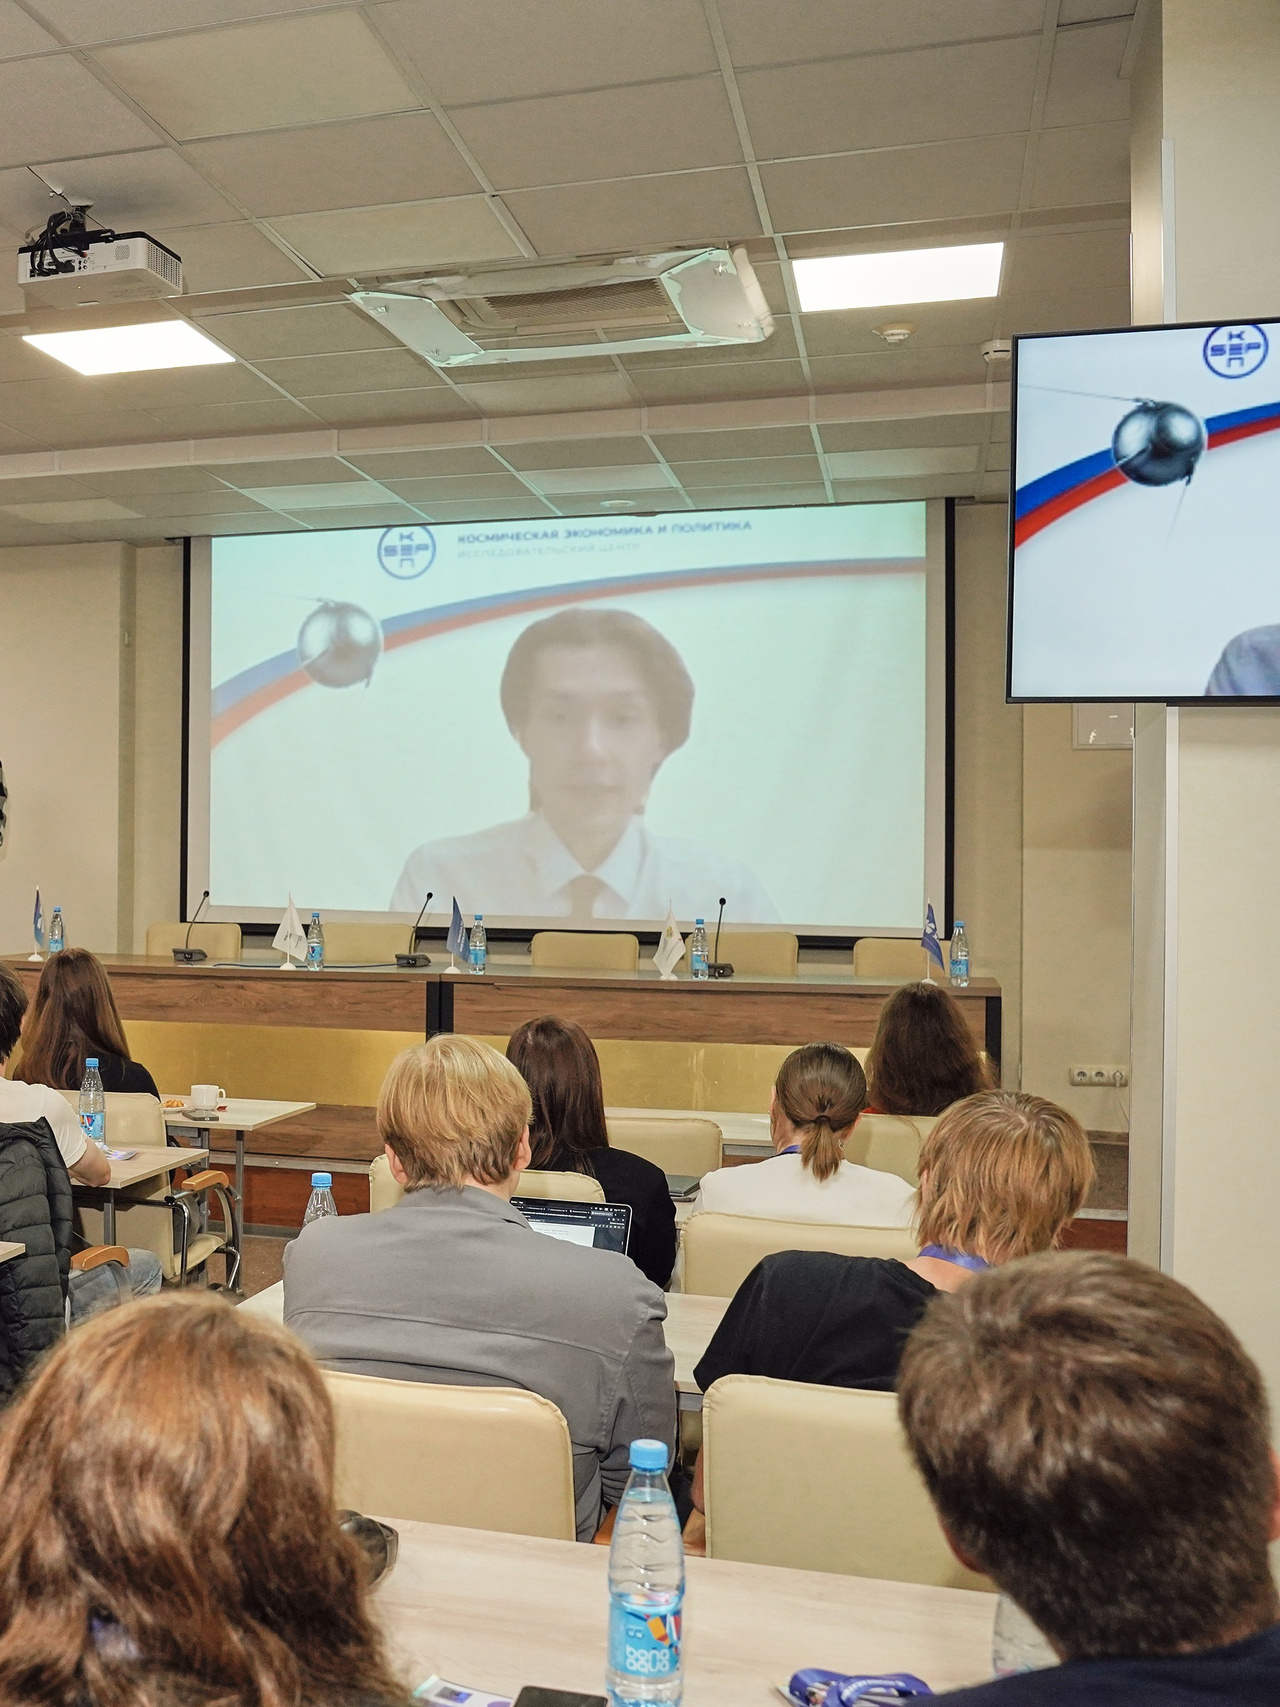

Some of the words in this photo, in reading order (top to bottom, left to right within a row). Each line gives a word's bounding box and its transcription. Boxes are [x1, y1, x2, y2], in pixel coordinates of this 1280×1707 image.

[458, 530, 559, 544] КОСМИЧЕСКАЯ
[564, 525, 654, 539] ЭКОНОМИКА
[658, 525, 667, 534] И
[671, 520, 752, 533] ПОЛИТИКА
